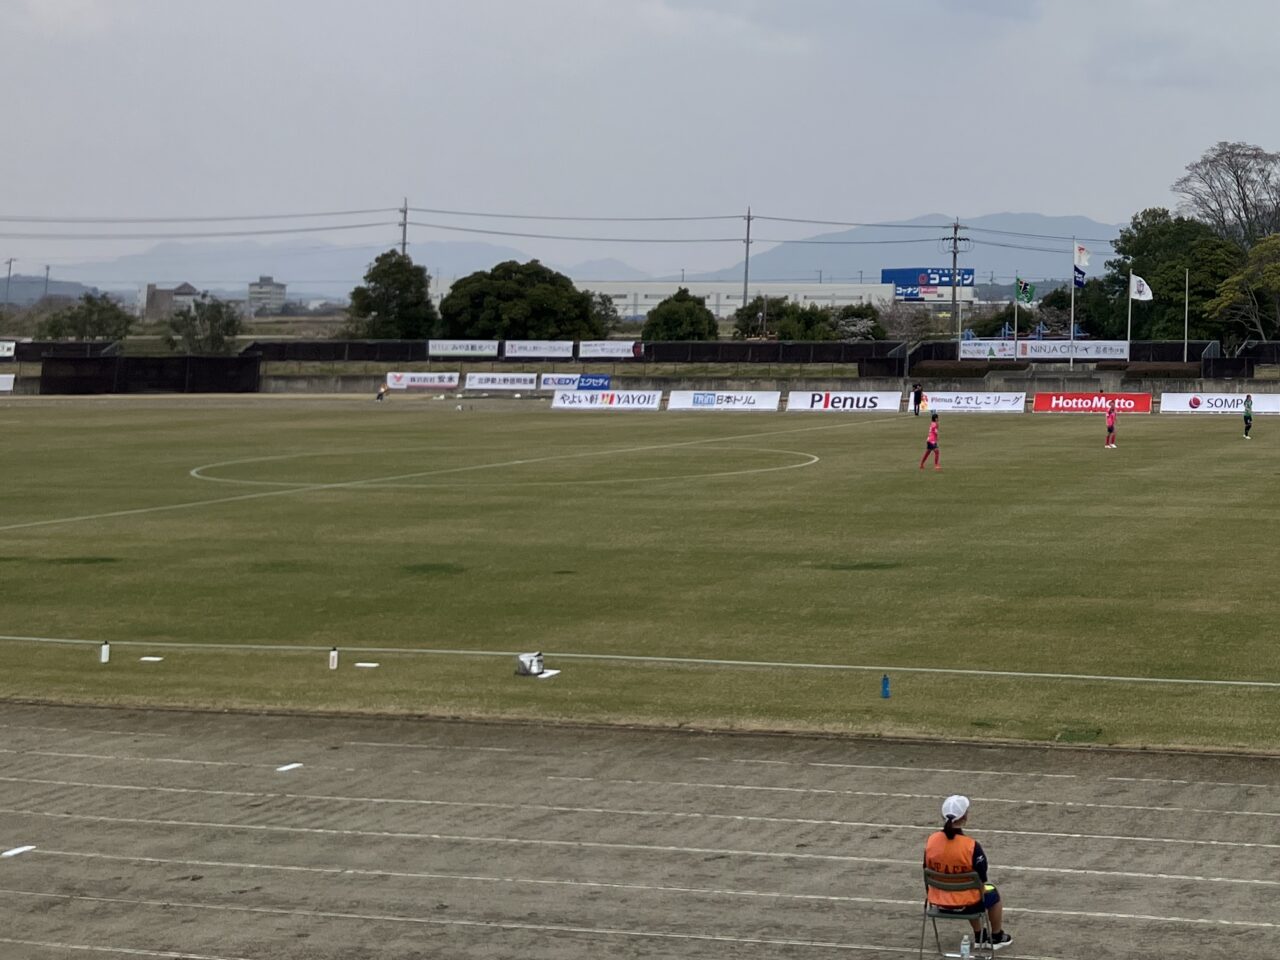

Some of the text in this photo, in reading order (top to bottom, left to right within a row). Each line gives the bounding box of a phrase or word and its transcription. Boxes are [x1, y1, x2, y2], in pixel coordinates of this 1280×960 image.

[543, 377, 578, 385] EXEDY
[580, 378, 609, 387] エクセディ
[560, 393, 598, 405] やよい軒
[617, 393, 651, 405] YAYOI
[716, 395, 756, 405] 日本トリム
[810, 392, 879, 409] Plenus
[954, 395, 1023, 406] なでしこリーグ
[1206, 397, 1253, 409] SOMP
